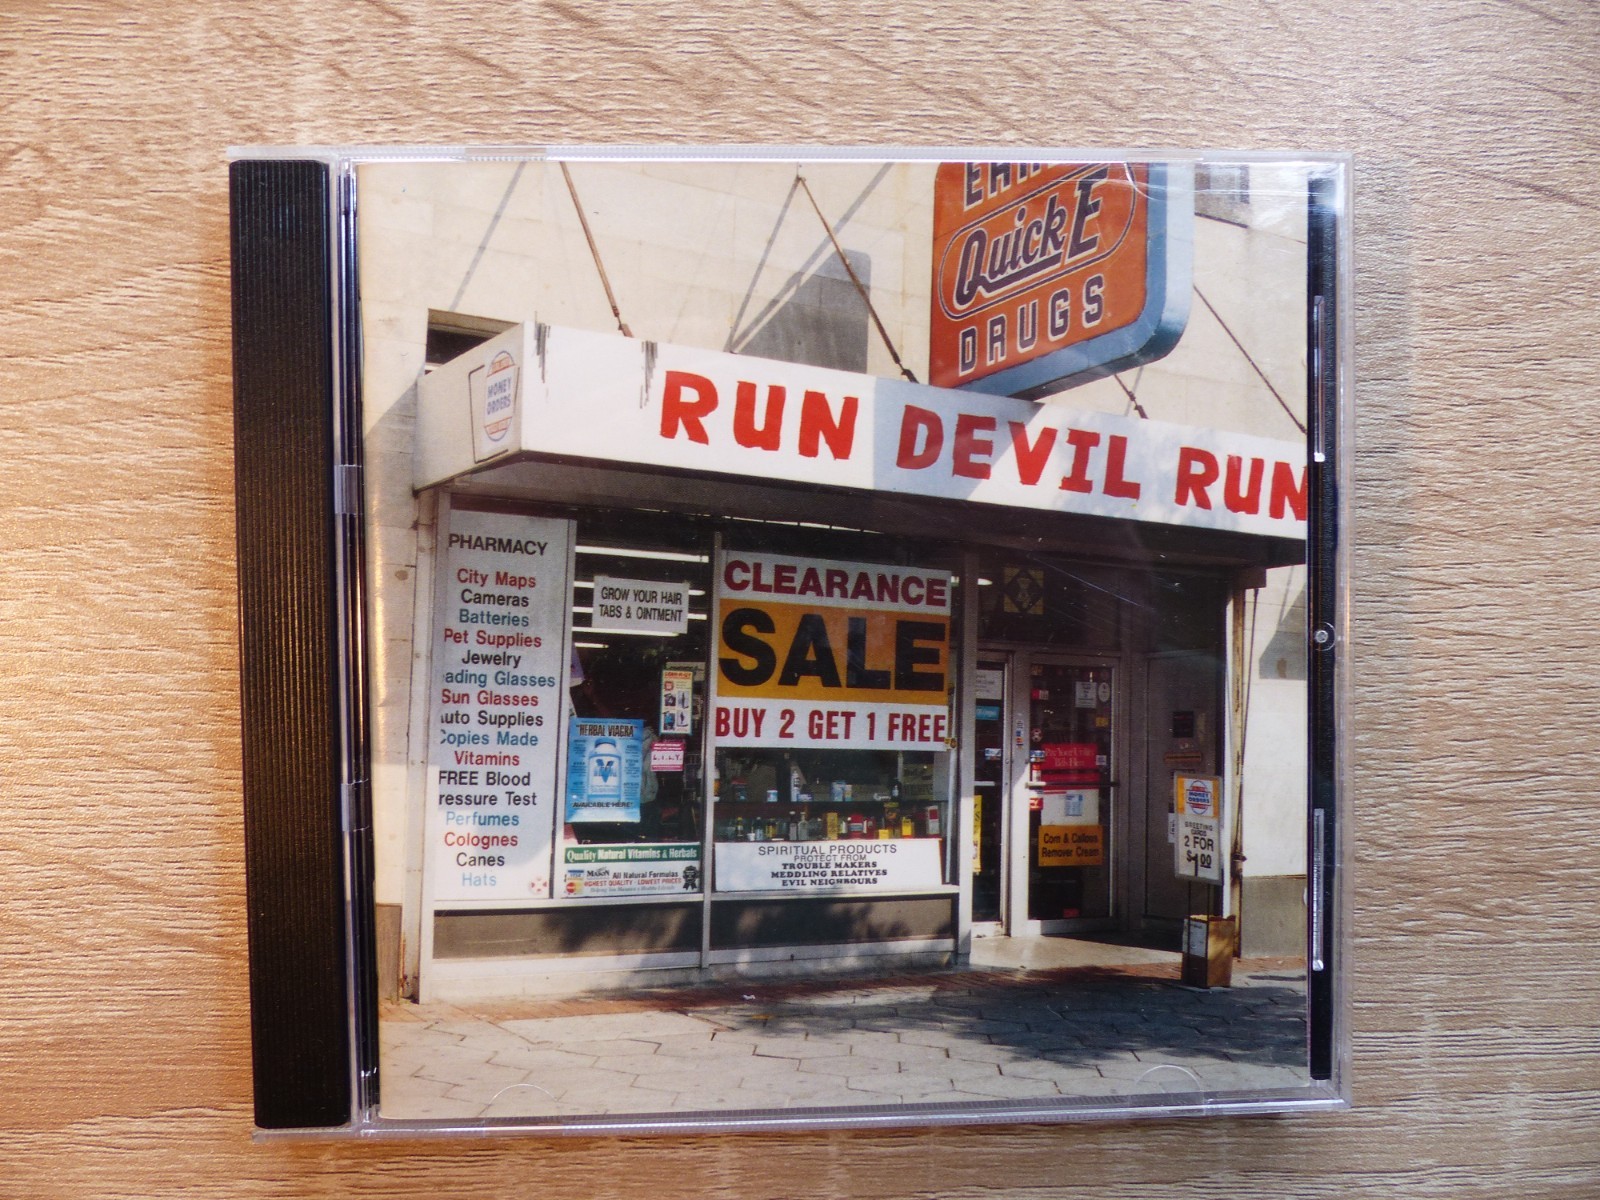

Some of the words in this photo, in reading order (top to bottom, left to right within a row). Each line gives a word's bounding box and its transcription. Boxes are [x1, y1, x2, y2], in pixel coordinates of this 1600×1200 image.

[958, 273, 1104, 377] DRUGS
[487, 377, 511, 399] MONEY
[487, 393, 511, 415] ORDERS
[660, 370, 859, 461] RUN
[896, 404, 1141, 500] DEVIL
[1174, 446, 1308, 521] RUN
[448, 533, 548, 556] PHARMACY
[457, 568, 488, 587] City
[495, 571, 536, 590] Maps
[724, 560, 947, 607] CLEARANCE
[461, 589, 529, 607] Cameras
[601, 586, 630, 601] GROW
[633, 589, 657, 603] YOUR
[661, 591, 682, 605] HAIR
[460, 608, 529, 627] Batteries
[599, 604, 622, 618] TABS
[626, 606, 632, 619] &
[636, 607, 683, 622] OINTMENT
[444, 628, 468, 643] Pet
[476, 630, 542, 648] Supplies
[718, 607, 946, 692] SALE
[461, 650, 521, 668] Jewelry
[443, 669, 487, 688] ading
[495, 670, 555, 687] Glasses
[441, 689, 469, 704] Sun
[477, 690, 538, 706] Glasses
[477, 710, 543, 728] Supplies
[715, 707, 766, 738] BUY
[779, 709, 795, 739] 2
[808, 710, 856, 740] GET
[867, 712, 876, 740] 1
[888, 713, 946, 742] FREE
[497, 731, 538, 746] Made
[454, 751, 520, 766] Vitamins
[439, 770, 478, 786] FREE
[486, 771, 530, 786] Blood
[505, 791, 537, 806] Test
[446, 811, 519, 827] Perfumes
[444, 832, 518, 849] Colognes
[758, 845, 825, 855] SPIRITUAL
[829, 844, 897, 854] PRODUCTS
[1184, 835, 1190, 847] 2
[1193, 836, 1214, 851] FOR
[456, 852, 505, 867] Canes
[567, 848, 596, 862] Quality
[598, 848, 626, 860] Natural
[628, 848, 660, 859] Vitamins
[669, 848, 697, 859] Herbals
[771, 870, 827, 878] MEDDLING
[831, 869, 888, 877] RELATIVES
[782, 862, 831, 870] TROUBLE
[834, 861, 877, 869] MAKERS
[462, 872, 497, 887] Hats
[810, 878, 878, 886] NEIGHBOURS
